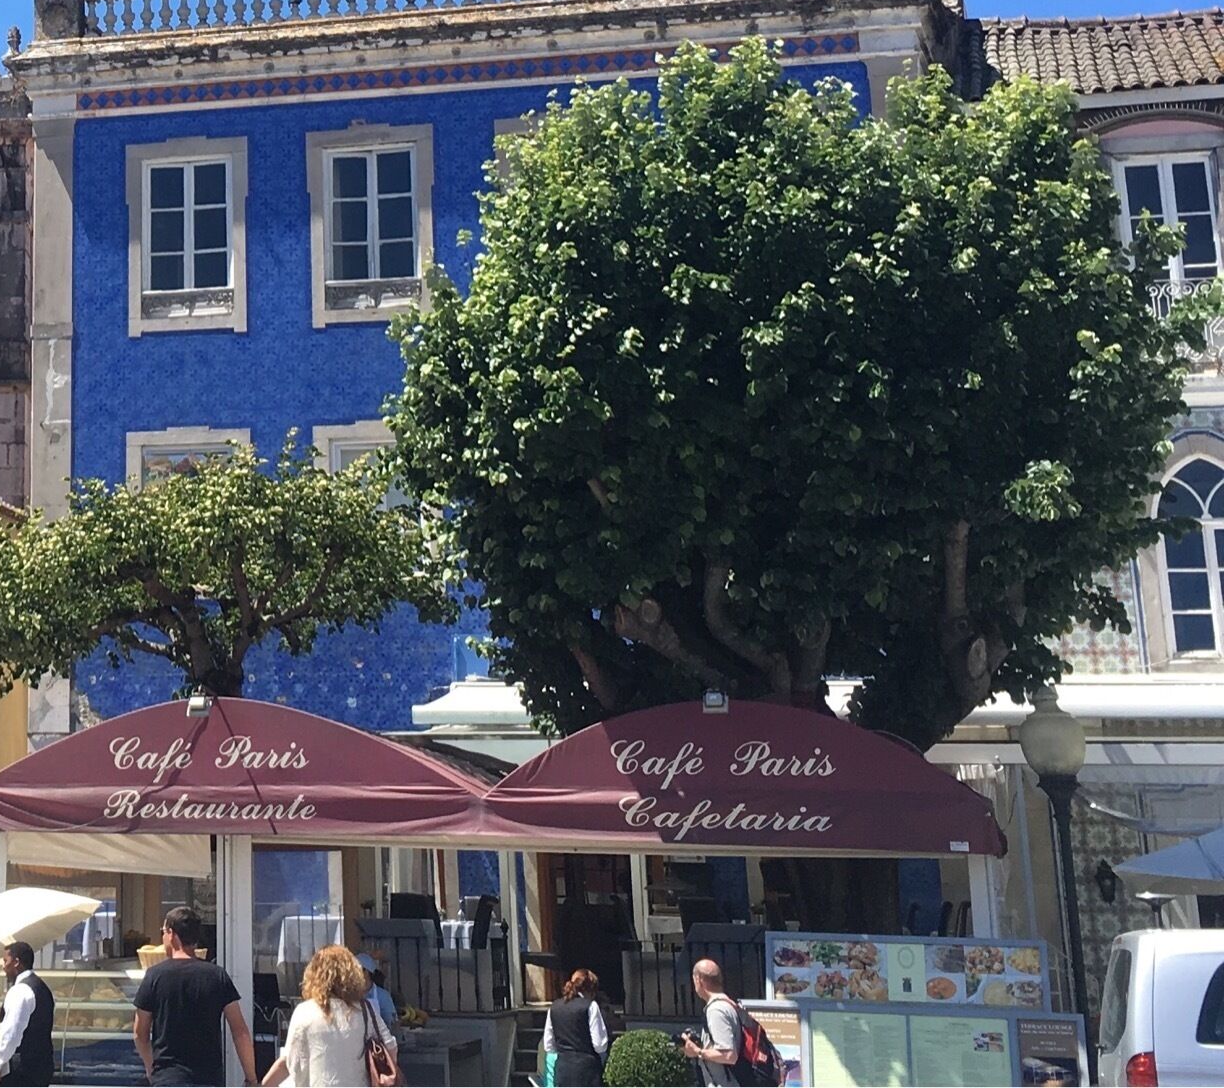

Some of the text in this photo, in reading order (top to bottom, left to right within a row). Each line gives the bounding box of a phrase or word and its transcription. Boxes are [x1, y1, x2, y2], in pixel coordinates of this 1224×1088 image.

[109, 735, 310, 783] Café Paris
[610, 740, 837, 790] Café Paris
[103, 789, 318, 820] Restaurante
[619, 796, 834, 841] Cafetaria
